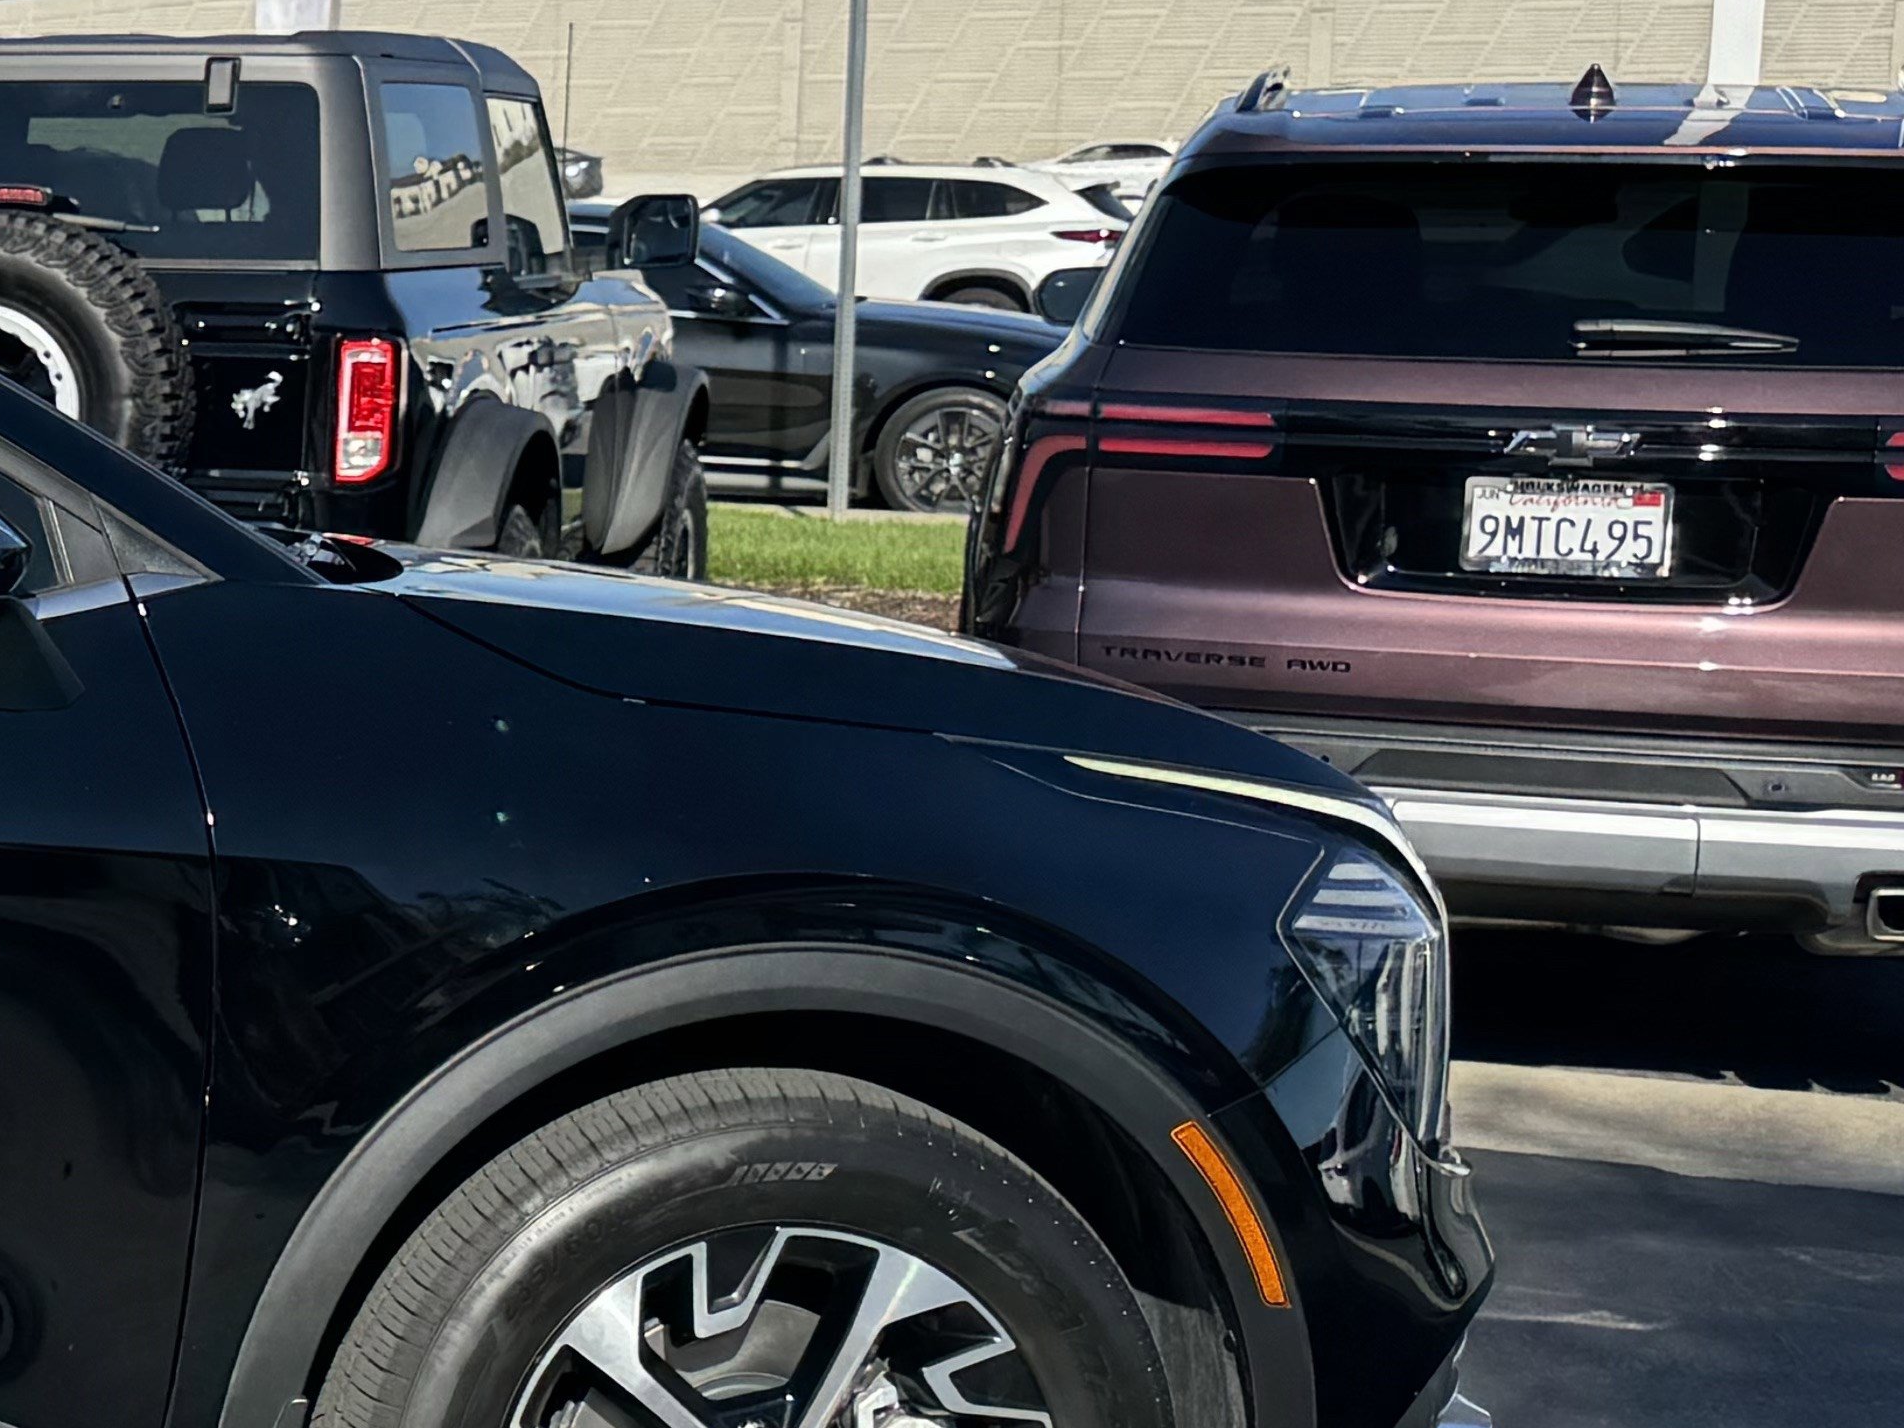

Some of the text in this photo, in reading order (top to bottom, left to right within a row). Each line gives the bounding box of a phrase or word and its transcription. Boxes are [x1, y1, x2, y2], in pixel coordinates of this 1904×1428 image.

[1478, 514, 1653, 560] 9MTC495
[1102, 645, 1351, 673] TRAVERSE AWD
